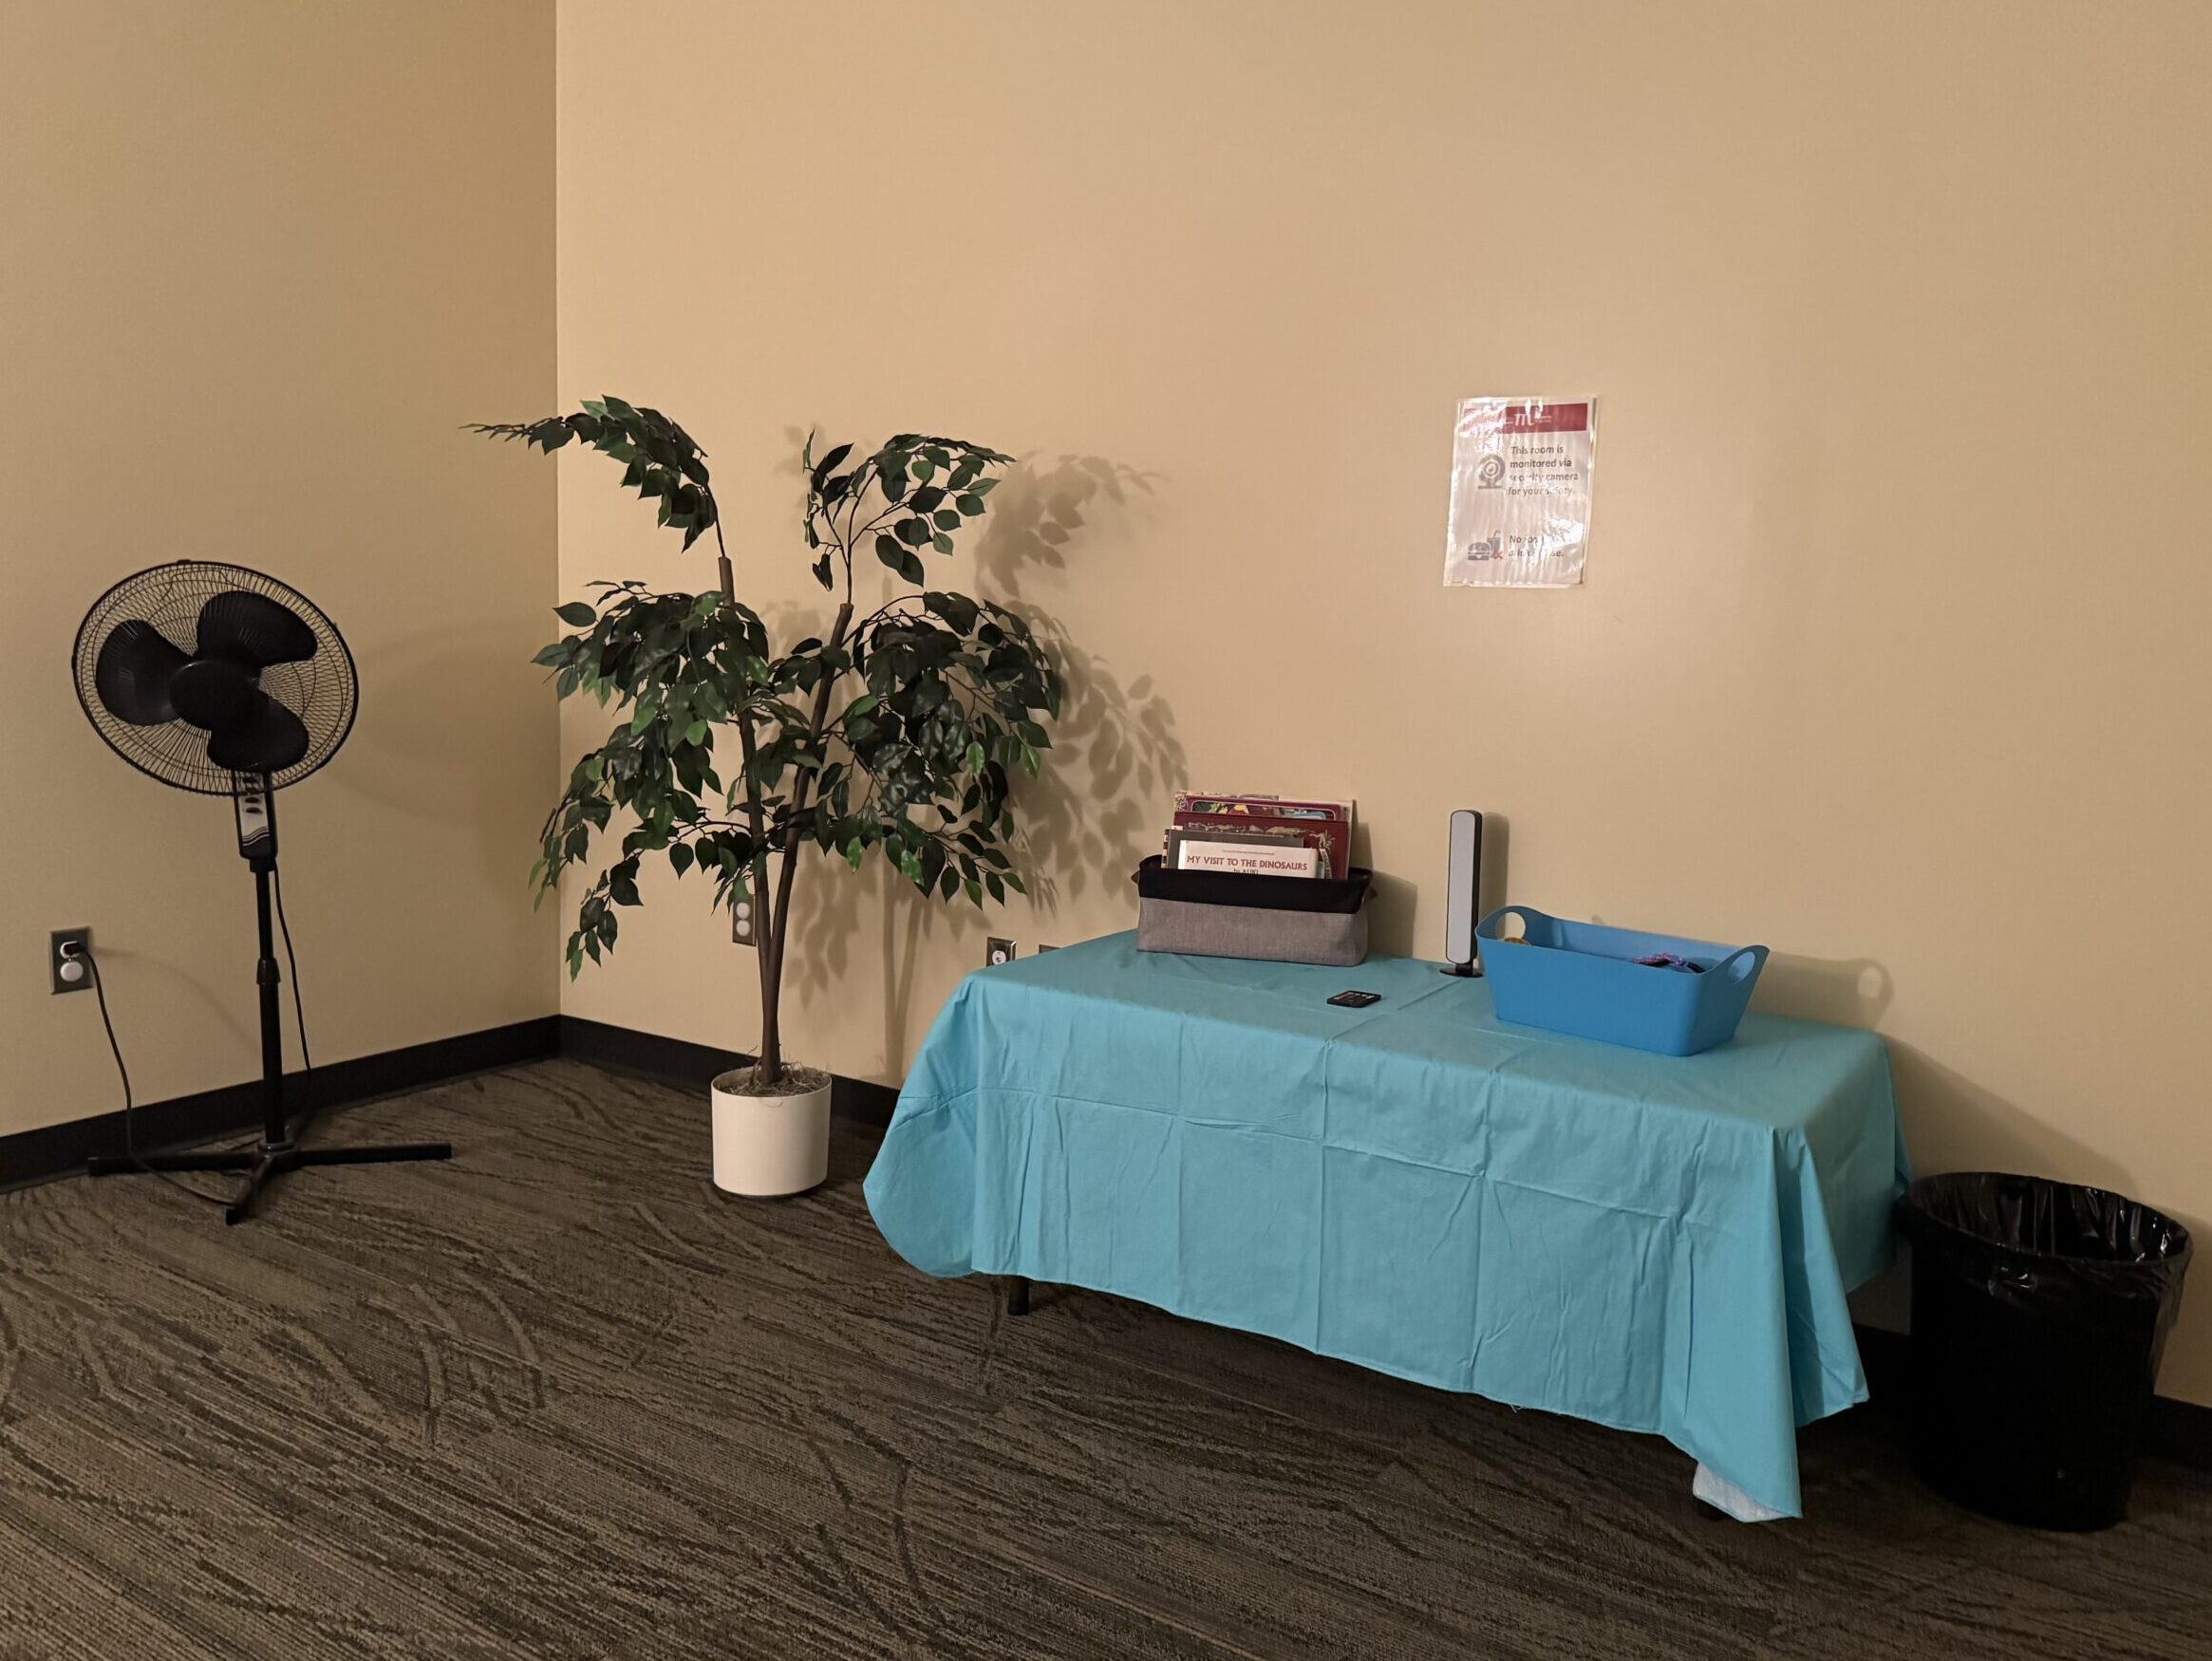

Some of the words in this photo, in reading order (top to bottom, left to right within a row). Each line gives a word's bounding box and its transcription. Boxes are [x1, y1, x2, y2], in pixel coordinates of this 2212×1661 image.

[1511, 446, 1528, 455] This
[1530, 446, 1554, 455] room
[1557, 444, 1564, 453] is
[1509, 458, 1557, 468] monitored
[1559, 457, 1572, 467] via
[1546, 473, 1579, 481] camera
[1508, 486, 1521, 495] for
[1523, 487, 1544, 496] your
[1509, 534, 1523, 544] No
[1187, 855, 1201, 864] MY
[1204, 856, 1225, 865] VISIT
[1227, 857, 1239, 867] TO
[1241, 858, 1257, 868] THE
[1259, 859, 1307, 870] DINOSAURS
